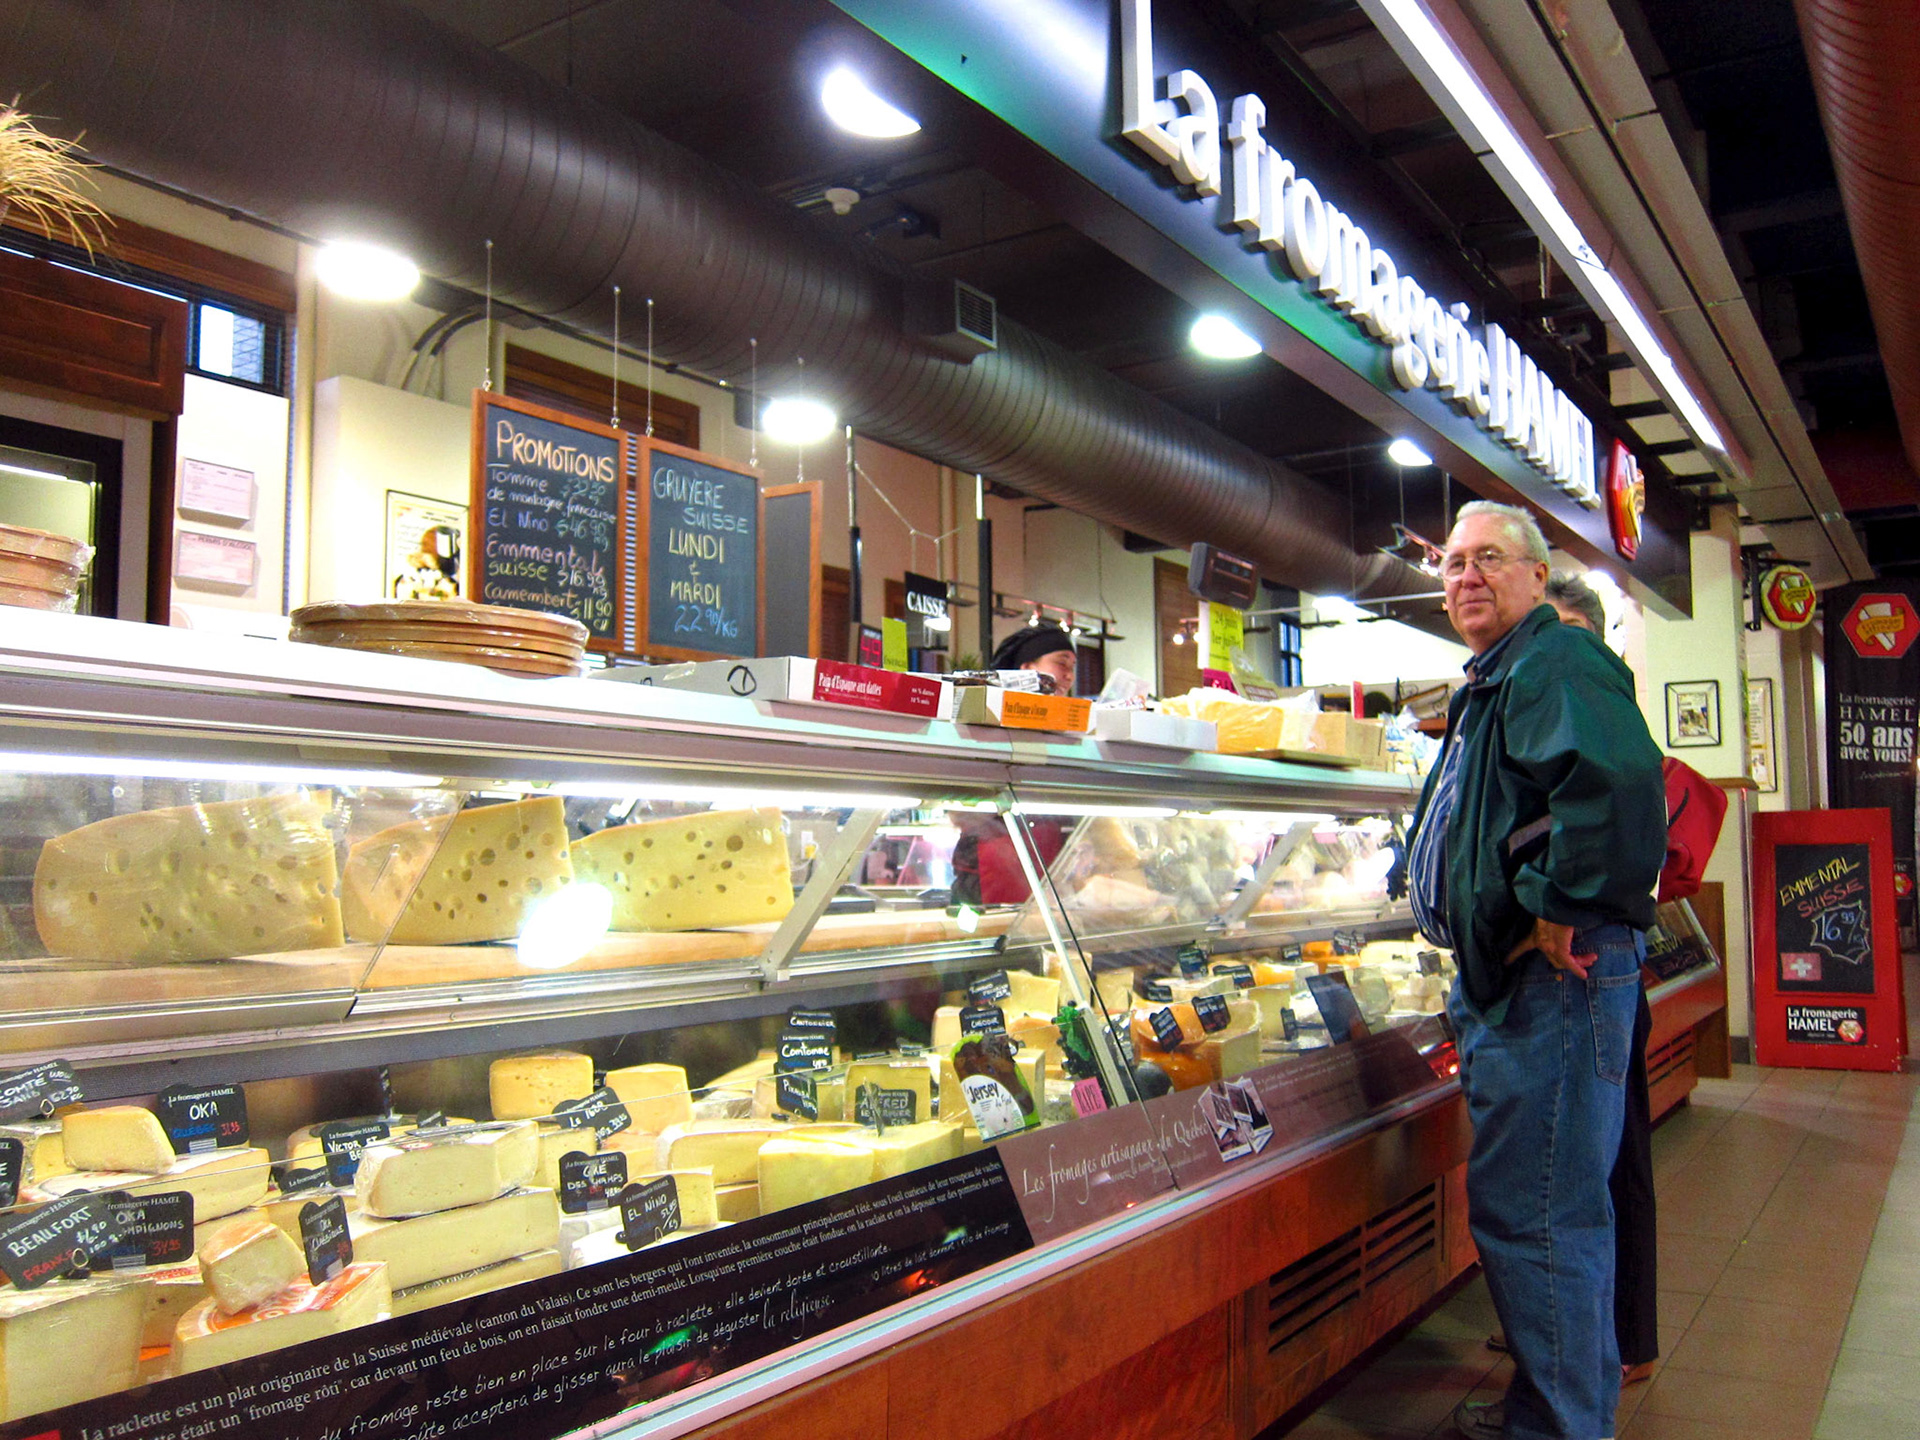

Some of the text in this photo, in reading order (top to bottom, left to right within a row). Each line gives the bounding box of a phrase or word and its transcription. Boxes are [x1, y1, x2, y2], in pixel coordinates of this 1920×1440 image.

[1121, 0, 1602, 508] La fromagerie HAMEL
[496, 419, 615, 483] PROMOTIONS
[487, 463, 549, 492] Tomme
[487, 486, 506, 501] de
[488, 507, 508, 528] El
[683, 507, 749, 534] SUISSE
[487, 533, 604, 577] Emmental
[668, 527, 725, 564] LUNDI
[484, 581, 578, 609] Camembert
[670, 580, 722, 610] MARDI
[906, 590, 949, 619] CAISSE
[856, 680, 867, 694] aux
[866, 681, 882, 696] dattes
[1839, 692, 1916, 709] La fromagerie
[1839, 705, 1915, 723] HAMEL
[1840, 722, 1914, 749] 50 ans
[1840, 746, 1914, 764] avec vous!
[1780, 857, 1861, 907] EMMENTAL
[1797, 877, 1865, 919] SUISSE
[1788, 1007, 1858, 1022] La fromagerie
[1788, 1017, 1836, 1033] HAMEL
[33, 1061, 58, 1074] HAMEL
[177, 1086, 236, 1102] fromagerie HAMEL
[969, 1081, 999, 1105] Jersey
[189, 1100, 219, 1121] OKA
[329, 1125, 382, 1140] La fromagerie HAMEL
[327, 1136, 362, 1154] VICTOR
[600, 1155, 620, 1164] HAMEL
[288, 1170, 326, 1188] La fromagerie
[567, 1180, 588, 1191] DES
[652, 1179, 671, 1192] HAMEL
[1023, 1167, 1046, 1197] Les
[1044, 1143, 1097, 1223] fromages
[107, 1195, 181, 1212] fromagerie HAMEL
[6, 1207, 50, 1236] fromagerie
[115, 1209, 146, 1226] OKA
[627, 1208, 642, 1222] EL
[8, 1205, 92, 1259] BEAUFORT
[81, 1428, 104, 1440] La
[108, 1409, 171, 1437] raclette
[175, 1401, 198, 1418] est
[201, 1395, 223, 1410] un
[226, 1385, 257, 1408] plat
[260, 1364, 330, 1393] originaire
[333, 1357, 350, 1372] de
[352, 1352, 366, 1366] la
[368, 1342, 408, 1361] Suisse
[410, 1321, 473, 1349] médiévale
[475, 1310, 518, 1329] (canton
[520, 1304, 536, 1317] du
[576, 1287, 590, 1300] Ce
[592, 1282, 614, 1296] sont
[614, 1277, 630, 1289] les
[630, 1266, 666, 1284] bergers
[667, 1259, 683, 1277] qui
[682, 1255, 704, 1269] l'ont
[740, 1239, 752, 1252] la
[752, 1224, 802, 1247] consommant
[802, 1204, 857, 1235] principalement
[180, 1419, 216, 1440] était
[219, 1414, 241, 1429] un
[350, 1374, 370, 1389] car
[374, 1360, 418, 1382] devant
[420, 1355, 438, 1367] un
[440, 1347, 460, 1362] feu
[462, 1341, 477, 1355] de
[508, 1329, 523, 1340] on
[525, 1324, 540, 1335] en
[541, 1312, 574, 1331] faisait
[574, 1302, 608, 1320] fondre
[610, 1296, 630, 1309] une
[688, 1263, 736, 1285] Lorsqu'une
[736, 1251, 773, 1273] première
[773, 1241, 801, 1257] couche
[802, 1234, 819, 1248] était
[846, 1223, 857, 1232] on
[854, 1219, 865, 1231] la
[320, 1427, 341, 1440] du
[348, 1404, 419, 1435] fromage
[426, 1385, 468, 1411] reste
[474, 1374, 504, 1394] bien
[509, 1369, 526, 1382] en
[530, 1355, 568, 1382] place
[574, 1345, 598, 1361] sur
[604, 1334, 616, 1351] le
[619, 1328, 650, 1345] four
[655, 1318, 664, 1333] à
[667, 1303, 713, 1330] raclette
[725, 1291, 744, 1309] elle
[748, 1278, 782, 1303] devient
[785, 1269, 812, 1289] dorée
[815, 1262, 826, 1277] et
[452, 1394, 529, 1430] acceptera
[532, 1385, 548, 1401] de
[554, 1371, 600, 1403] glisser
[605, 1356, 635, 1377] aura
[638, 1350, 651, 1365] le
[696, 1329, 709, 1343] de
[713, 1311, 760, 1341] déguster
[762, 1297, 775, 1329] la
[779, 1287, 836, 1341] religieuse.
